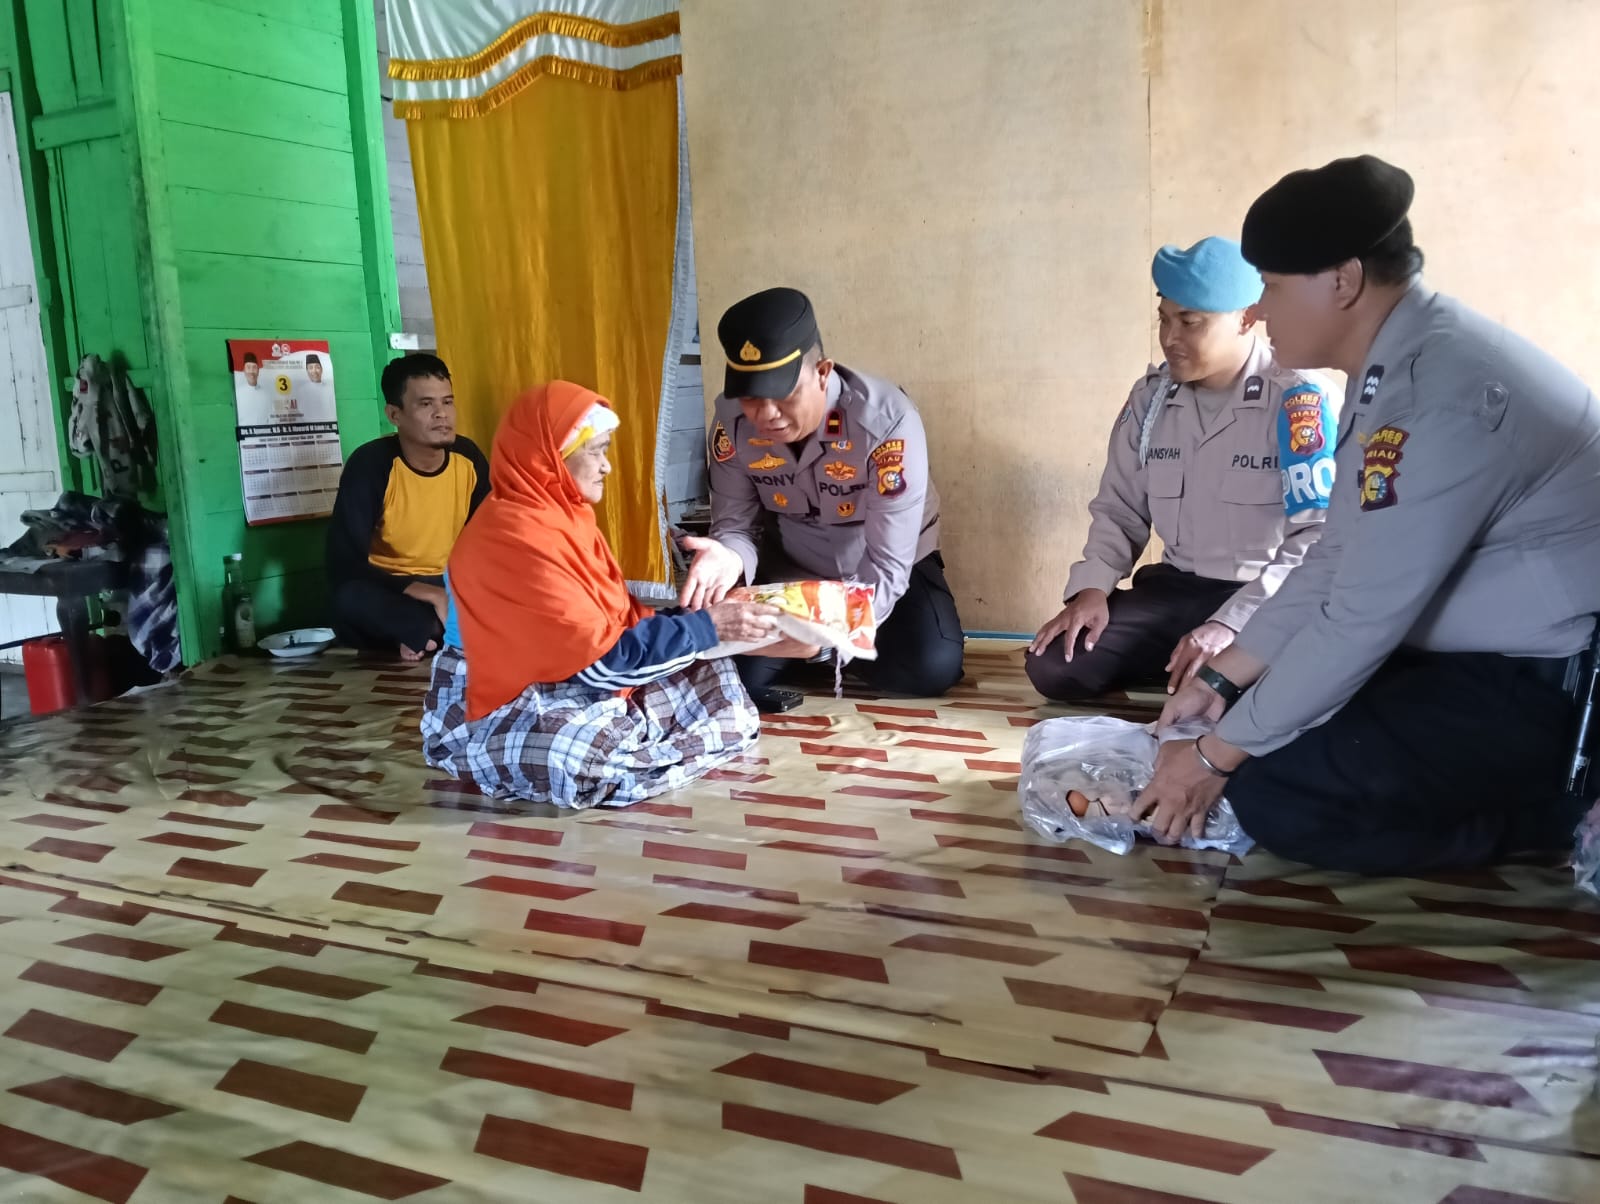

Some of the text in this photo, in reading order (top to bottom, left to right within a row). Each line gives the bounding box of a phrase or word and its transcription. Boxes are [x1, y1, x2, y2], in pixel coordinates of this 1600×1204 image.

[278, 378, 288, 391] 3
[1369, 429, 1403, 444] LRES
[1146, 447, 1180, 459] ANSYAH
[1232, 454, 1278, 469] POLRI
